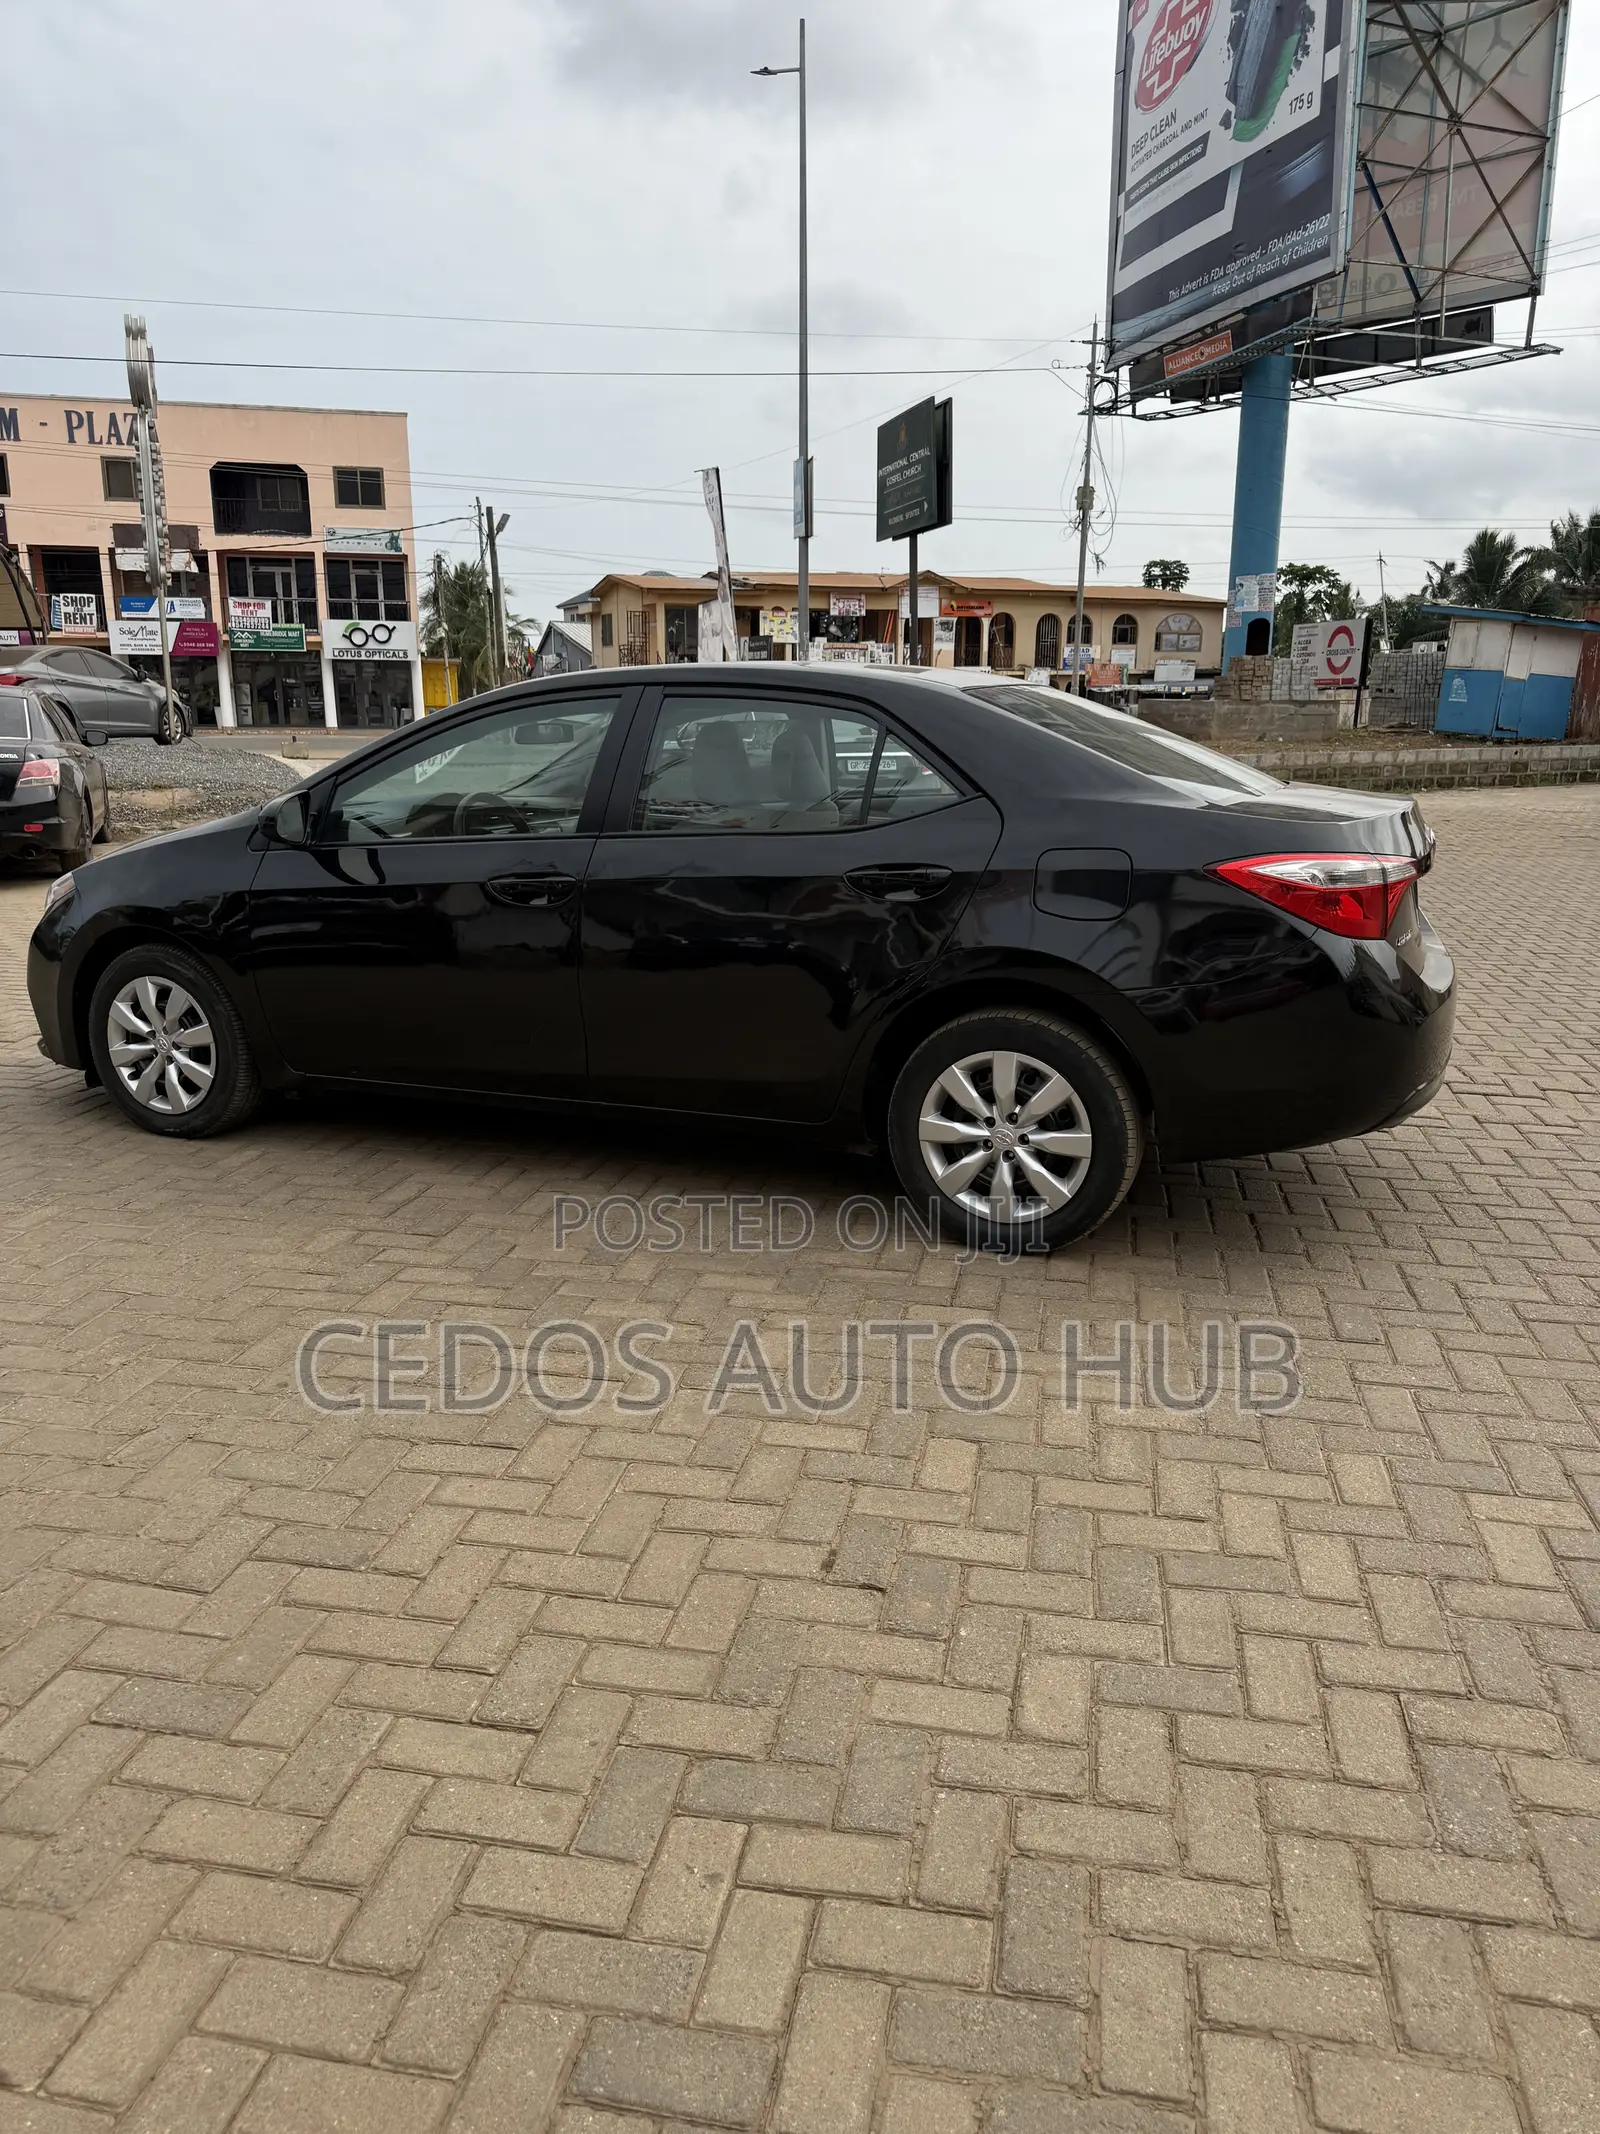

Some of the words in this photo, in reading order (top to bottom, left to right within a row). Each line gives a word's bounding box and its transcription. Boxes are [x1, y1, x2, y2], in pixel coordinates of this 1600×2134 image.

[1141, 5, 1208, 81] Lifebuoy
[1289, 92, 1304, 115] 175
[1306, 91, 1314, 110] g
[1131, 131, 1149, 160] DEEP
[1149, 108, 1177, 142] CLEAN
[1131, 149, 1153, 173] ACTIVATED
[1153, 129, 1179, 155] CHARCOAL
[1180, 120, 1193, 136] AND
[1193, 108, 1209, 126] MINT
[1158, 166, 1170, 180] CAUSE
[1168, 283, 1180, 302] This
[1180, 274, 1203, 296] Advert
[1203, 271, 1209, 284] is
[1209, 265, 1224, 282] FDA
[1225, 245, 1262, 276] approved
[1212, 281, 1231, 297] Keep
[1231, 272, 1246, 288] Out
[1246, 268, 1255, 284] of
[1255, 255, 1280, 276] Reach
[1281, 250, 1292, 266] of
[1292, 235, 1329, 260] Children
[1168, 351, 1199, 370] ALLIANCE
[1204, 340, 1228, 356] MEDIA
[64, 409, 159, 446] PLAZ
[879, 456, 908, 477] INTERNATIONAL
[909, 446, 931, 462] CENTRAL
[886, 473, 902, 487] GOSPEL
[903, 464, 921, 479] CHURCH
[62, 595, 94, 608] SHOP
[232, 601, 252, 610] SHOP
[253, 602, 266, 610] FOR
[63, 612, 95, 625] RENT
[332, 649, 362, 658] LOTUS
[365, 650, 409, 659] OPTICALS
